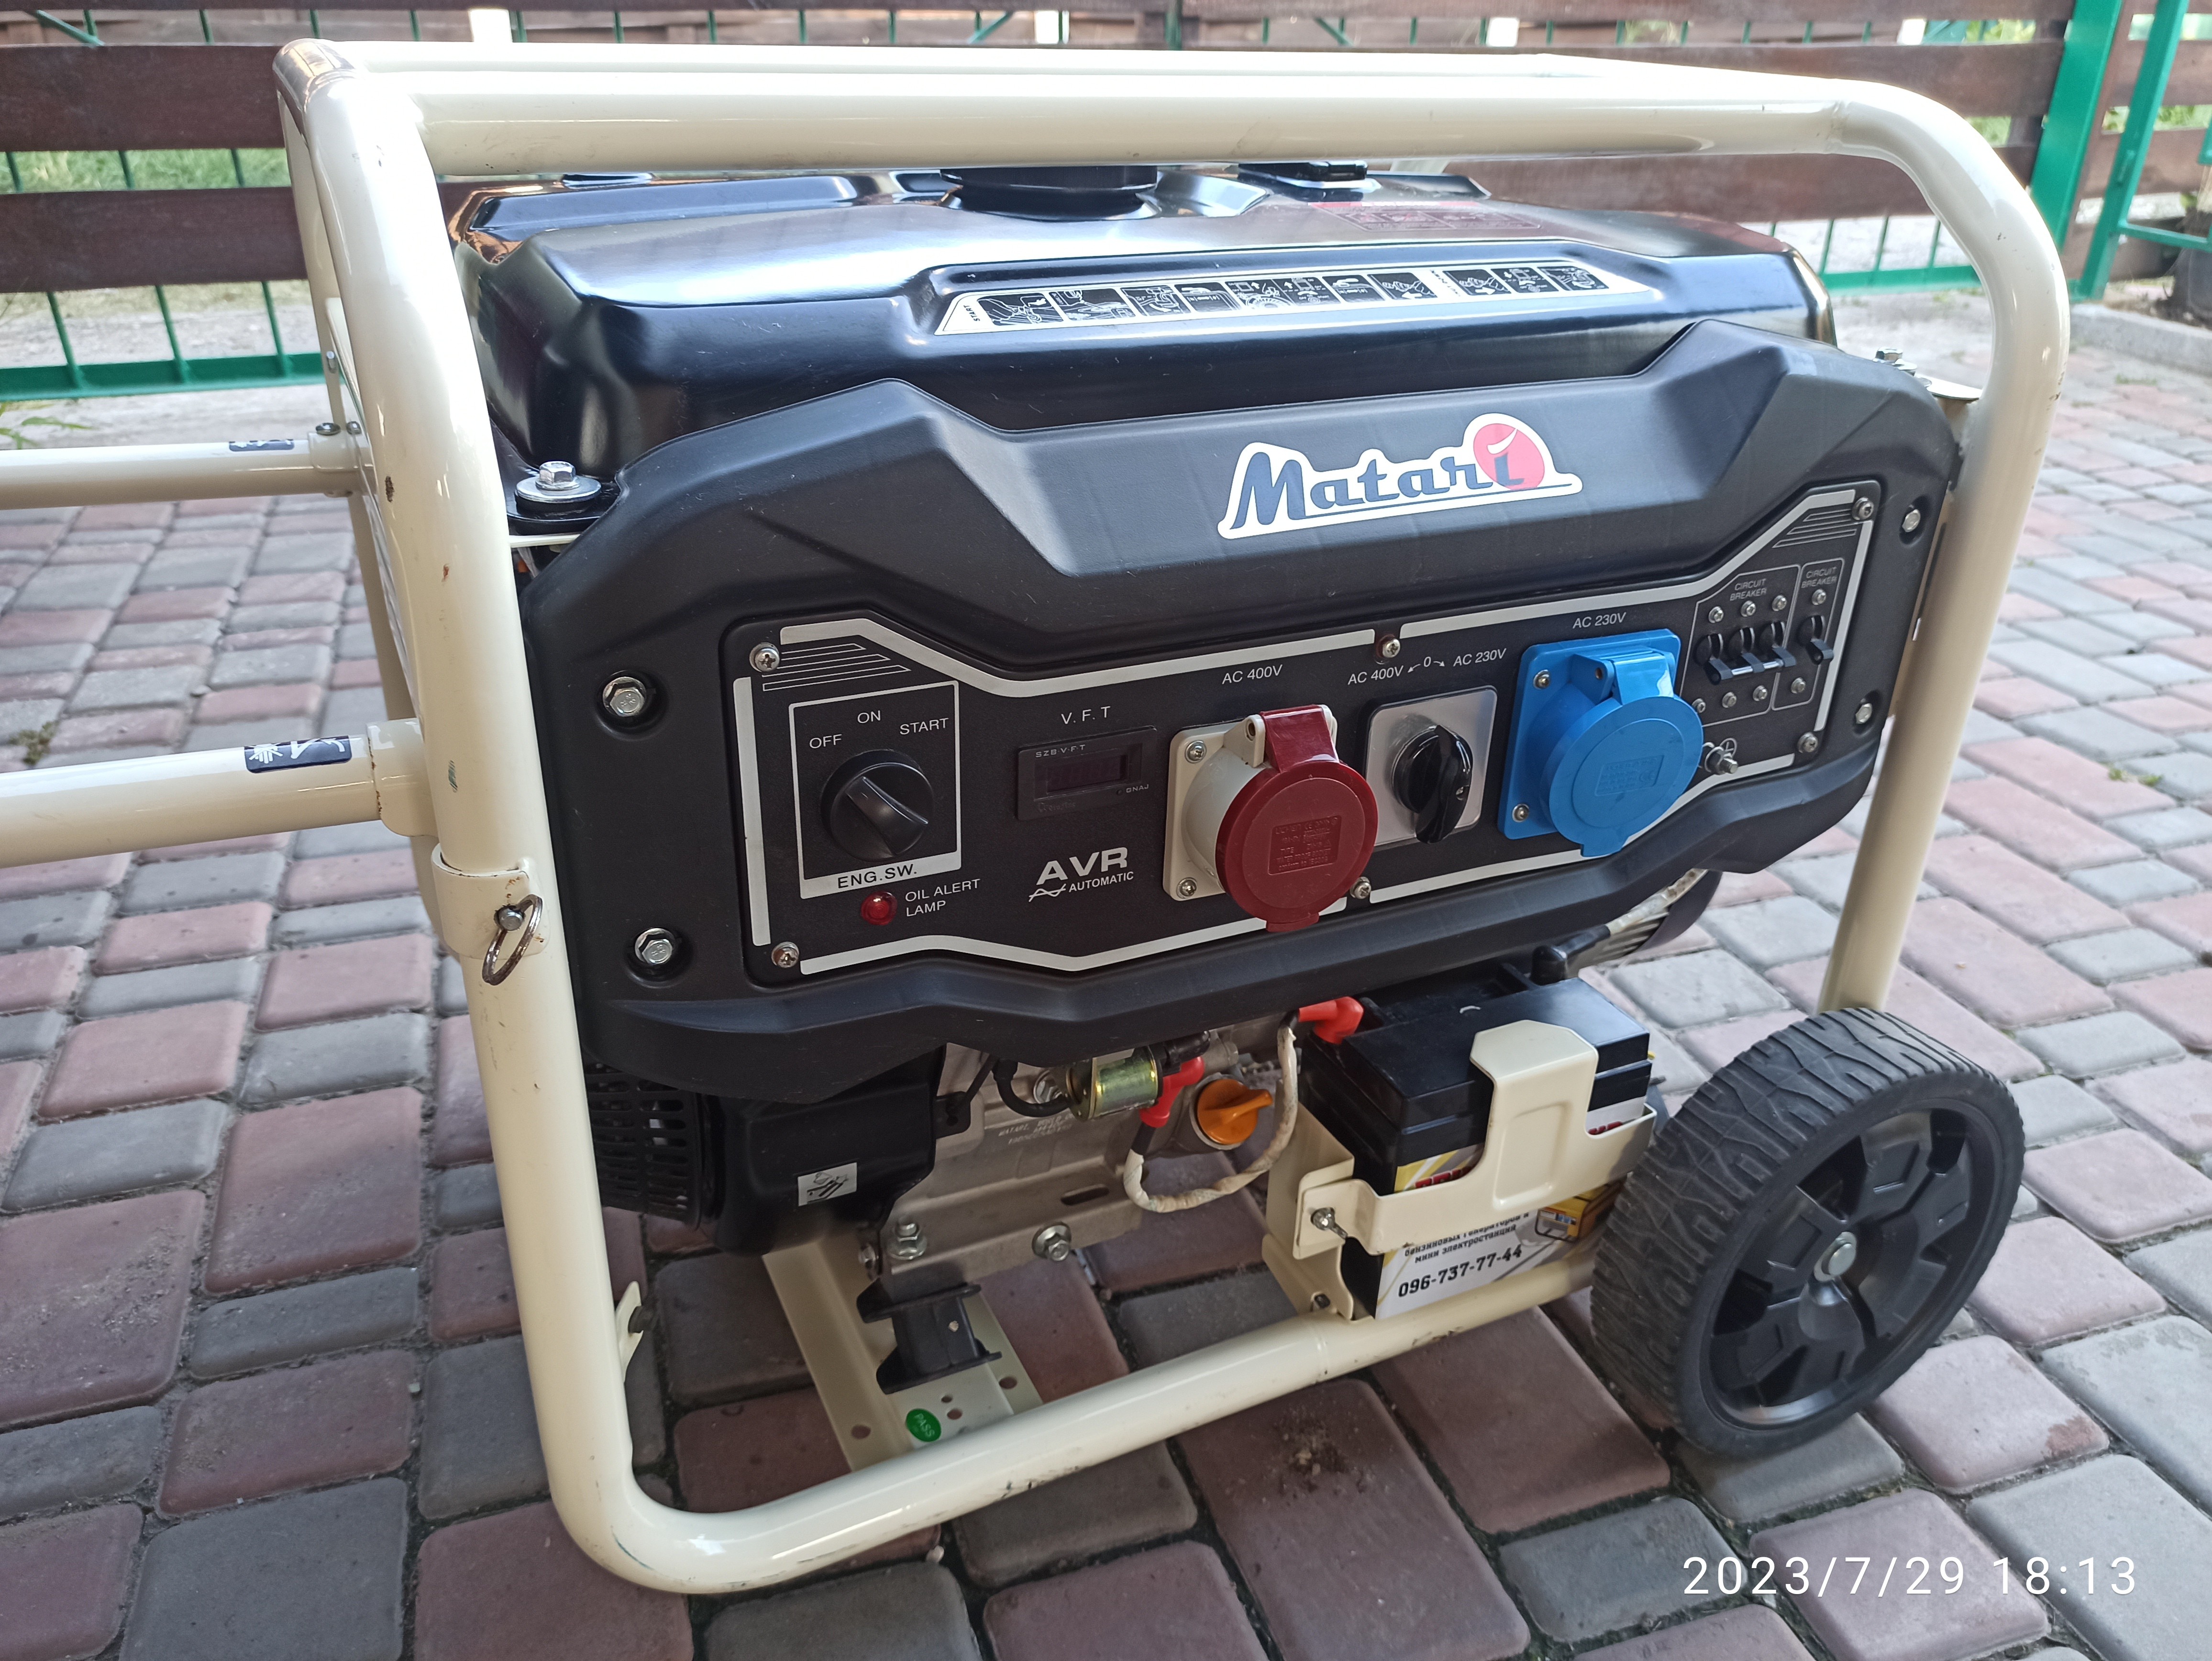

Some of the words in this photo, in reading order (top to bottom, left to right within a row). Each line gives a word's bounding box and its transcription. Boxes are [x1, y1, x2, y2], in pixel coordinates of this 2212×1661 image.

[963, 305, 980, 321] START
[1229, 428, 1544, 529] Matari
[1806, 566, 1837, 578] CIRCUIT
[1735, 578, 1767, 591] CIRCUIT
[1801, 576, 1837, 588] BREAKER
[1730, 587, 1767, 601] BREAKER
[1572, 616, 1593, 629] AC
[1595, 612, 1626, 626] 230V
[1222, 669, 1244, 685] AC
[1247, 664, 1283, 680] 400V
[1348, 671, 1368, 685] AC
[1371, 665, 1404, 681] 400V
[1453, 653, 1473, 667] AC
[1476, 648, 1507, 663] 230V
[857, 710, 881, 723] ON
[899, 717, 949, 735] START
[809, 734, 842, 749] OFF
[1126, 784, 1149, 793] GNAJ
[1036, 846, 1128, 886] AVR
[905, 890, 930, 902] OIL
[933, 878, 981, 897] ALERT
[1068, 871, 1134, 893] AUTOMATIC
[906, 899, 946, 917] LAMP
[1415, 1250, 1439, 1263] мини
[1441, 1224, 1516, 1254] электростанций
[1398, 1243, 1522, 1297] 096-737-77-44
[913, 1413, 935, 1438] PASS
